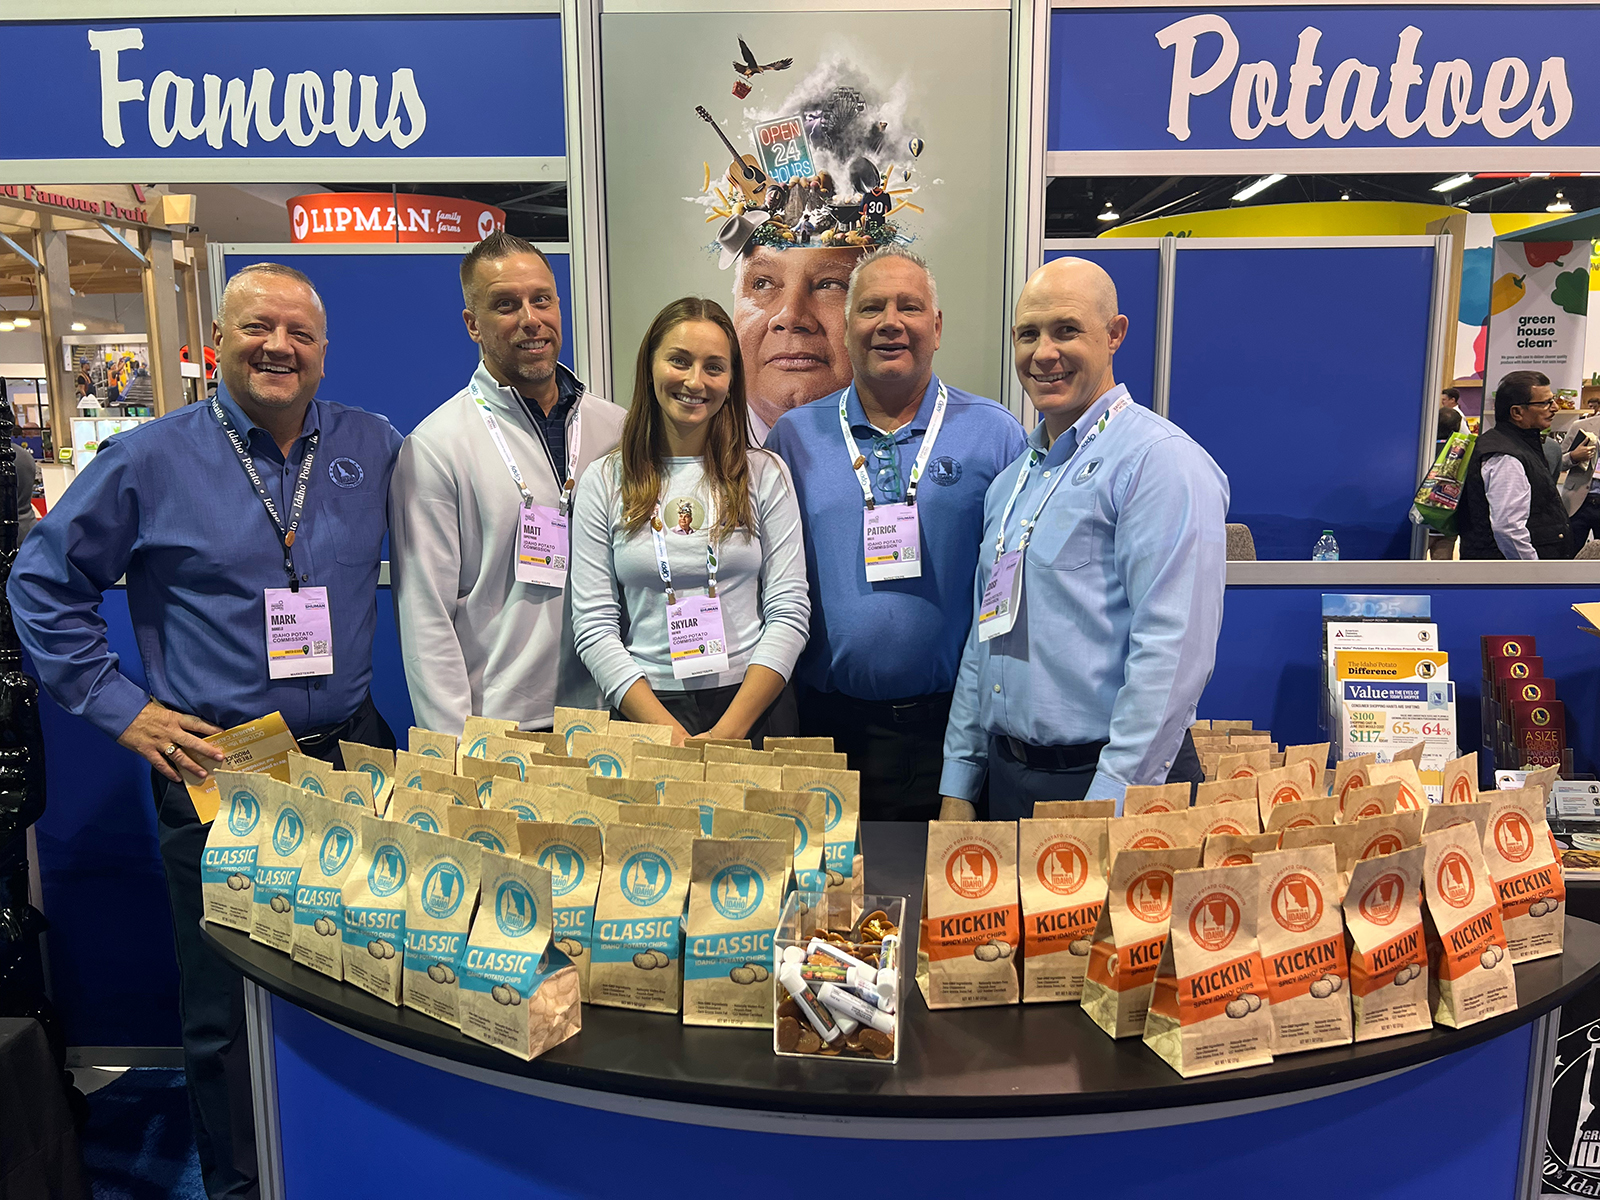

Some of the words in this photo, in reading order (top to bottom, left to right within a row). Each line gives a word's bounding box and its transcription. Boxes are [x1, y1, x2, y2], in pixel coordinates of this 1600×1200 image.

[1155, 13, 1573, 141] Potatoes
[88, 28, 427, 149] Famous
[759, 120, 802, 146] OPEN
[771, 139, 800, 167] 24
[769, 160, 812, 184] HOURS
[24, 185, 100, 213] Famous
[104, 201, 148, 223] Fruit
[868, 201, 883, 214] 30
[436, 210, 462, 223] family
[437, 222, 461, 234] farms
[1519, 316, 1555, 326] green
[1517, 327, 1555, 336] house
[242, 457, 260, 486] Potato
[301, 454, 313, 480] Potato
[524, 525, 541, 536] MATT
[867, 525, 896, 536] PATRICK
[1350, 602, 1401, 617] 2025
[271, 614, 296, 625] MARK
[671, 618, 698, 630] SKYLAR
[1349, 686, 1388, 698] Value
[1353, 712, 1374, 720] $100
[1350, 729, 1381, 743] $117
[1392, 722, 1419, 734] 65%
[1422, 722, 1451, 735] 64%
[1526, 731, 1533, 740] A
[1536, 731, 1557, 740] SIZE
[224, 749, 250, 762] PRODUCE
[234, 754, 252, 764] FRESH
[953, 836, 974, 845] POTATO
[1044, 834, 1063, 843] POTATO
[206, 849, 256, 866] CLASSIC
[257, 869, 295, 886] CLASSIC
[1500, 869, 1552, 900] KICKIN'
[296, 888, 341, 907] CLASSIC
[1503, 900, 1518, 908] SPICY
[1538, 889, 1554, 898] CHIPS
[344, 909, 400, 929] CLASSIC
[941, 910, 1010, 938] KICKIN'
[1036, 904, 1102, 934] KICKIN'
[600, 920, 672, 941] CLASSIC
[987, 931, 1006, 939] CHIPS
[1037, 935, 1056, 943] SPICY
[1081, 927, 1096, 935] CHIP
[1450, 913, 1493, 952] KICKIN'
[693, 934, 770, 958] CLASSIC
[1484, 935, 1496, 947] CHIPS
[719, 956, 742, 964] POTATO
[1129, 940, 1164, 968] KIC
[1274, 941, 1337, 978] KICKIN'
[1372, 931, 1420, 972] KICKIN'
[467, 949, 531, 974] CLASSIC
[484, 972, 504, 982] POTATO
[505, 976, 521, 984] CHIPS
[1191, 958, 1253, 999] KICKIN'
[1278, 978, 1296, 988] SPICY
[1319, 964, 1337, 974] CHIPS
[1193, 999, 1213, 1008] SPICY
[1236, 982, 1254, 995] CHIPS
